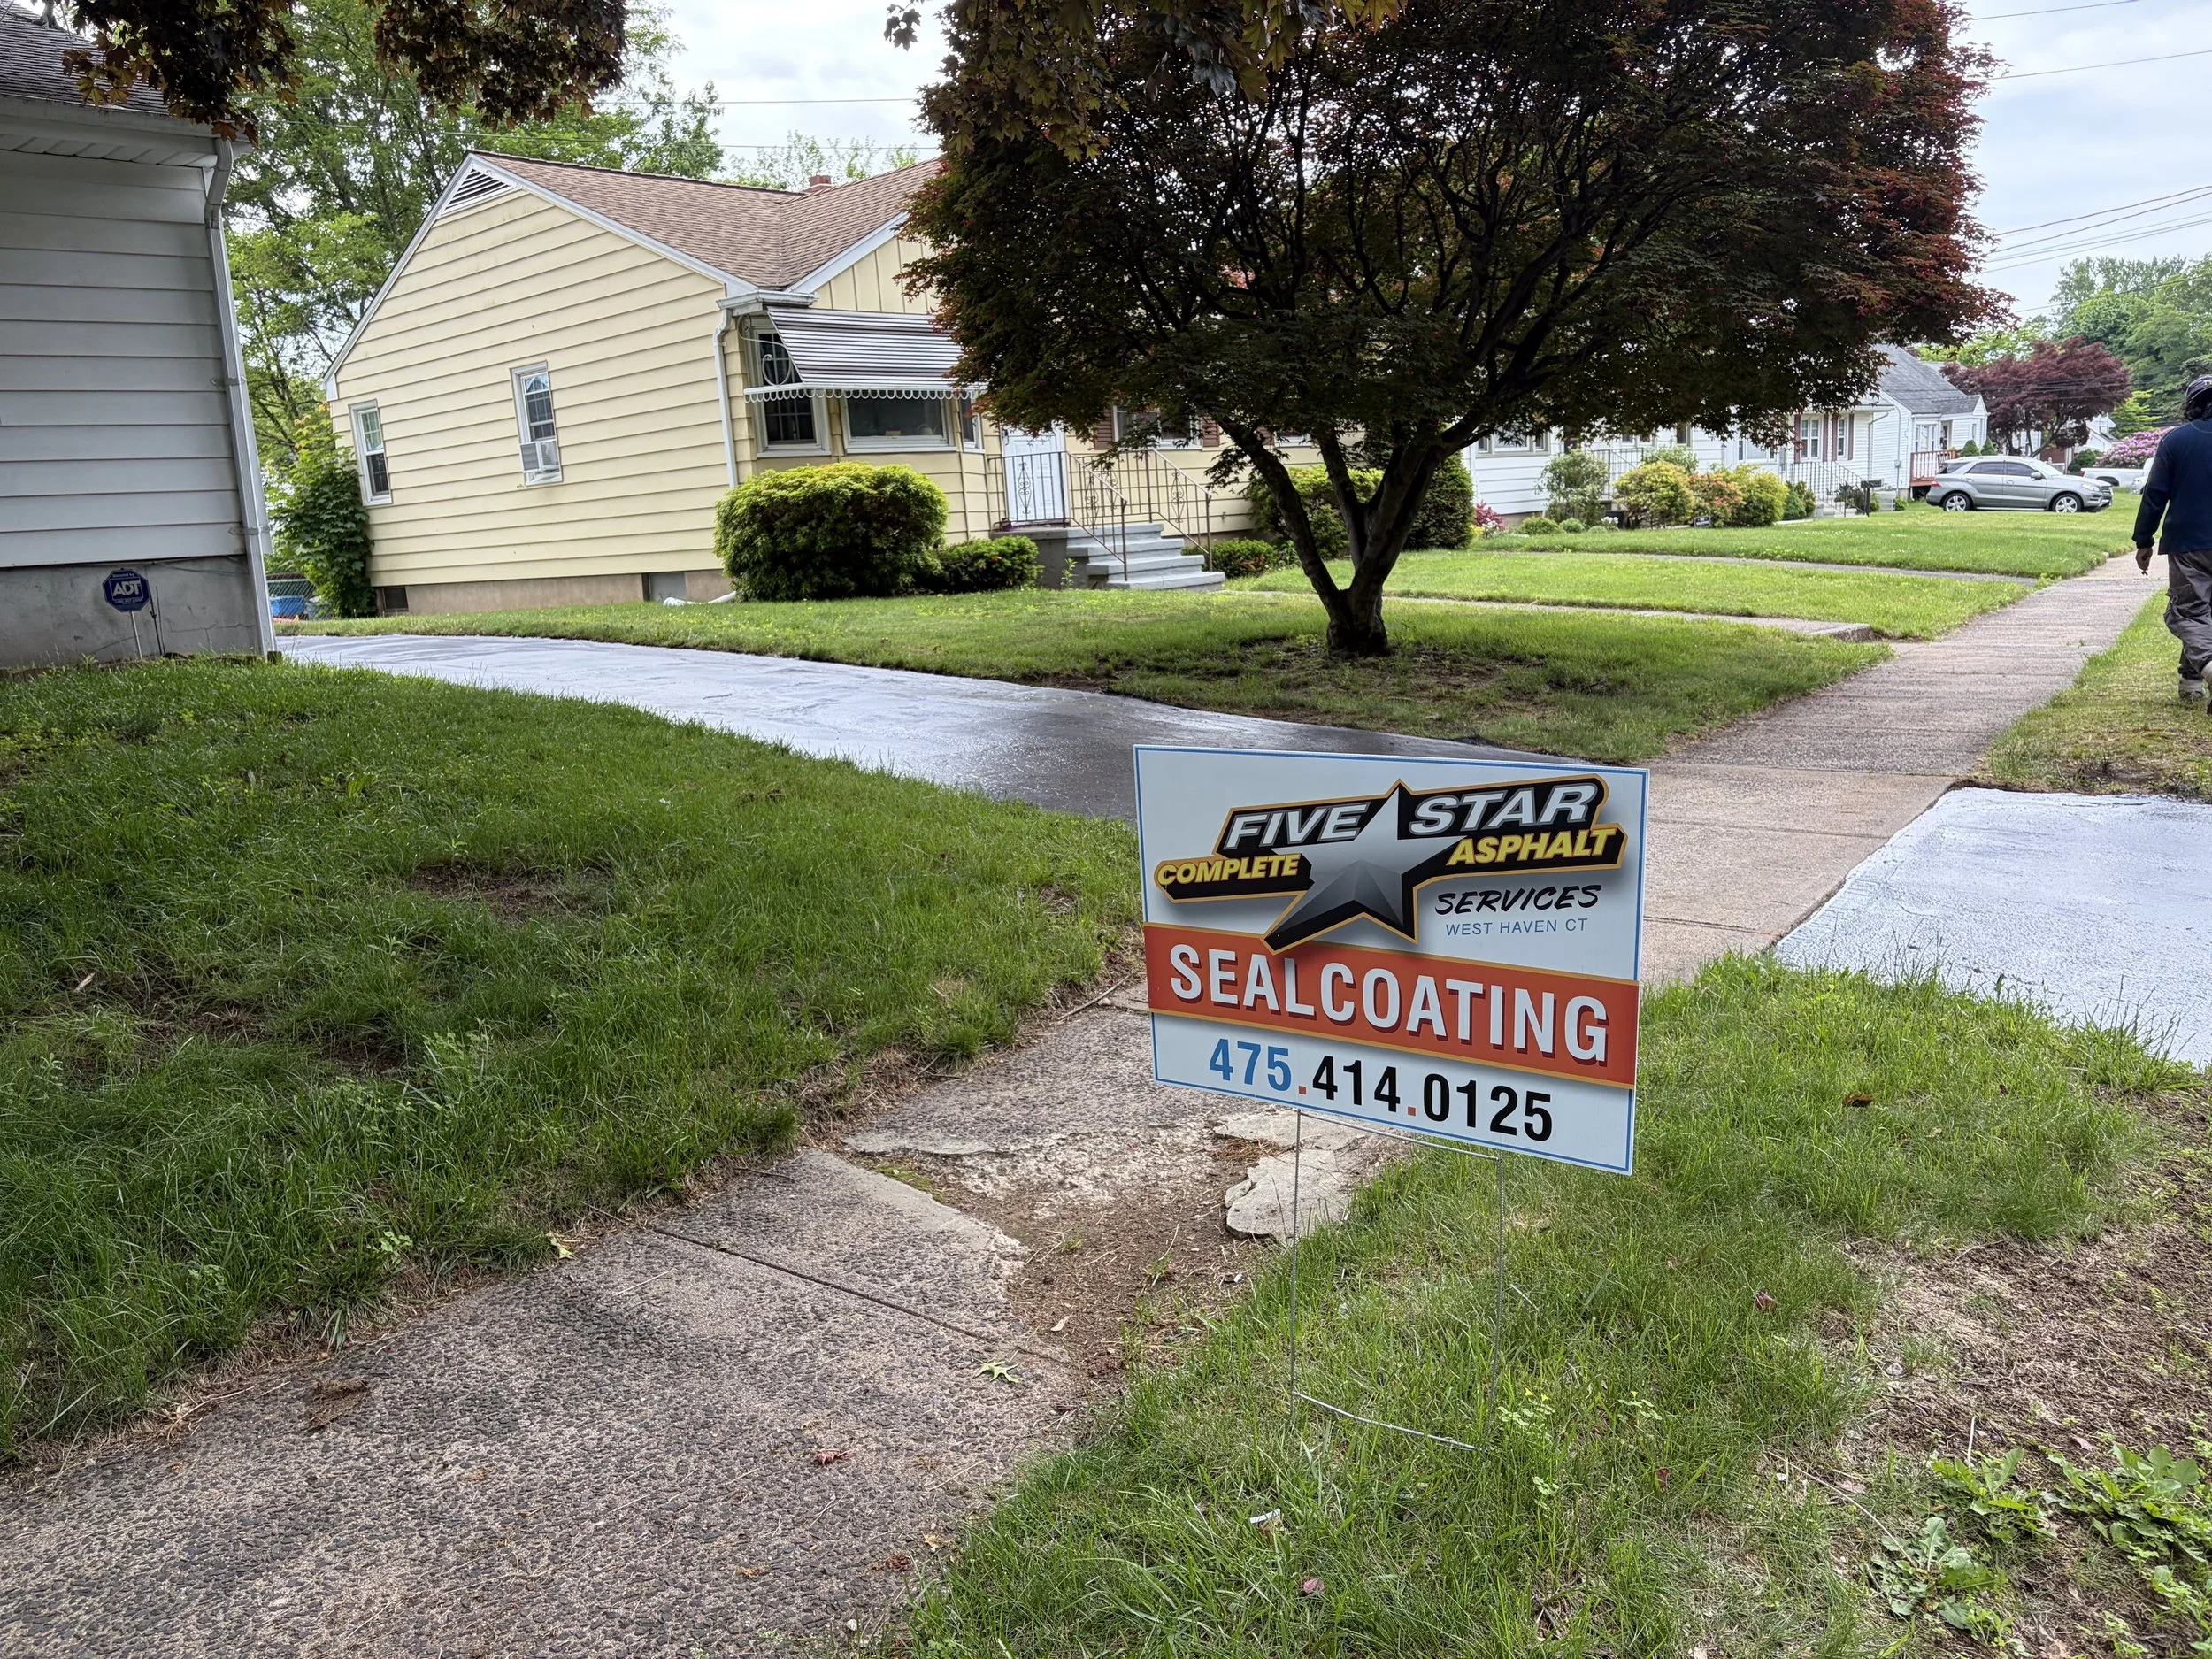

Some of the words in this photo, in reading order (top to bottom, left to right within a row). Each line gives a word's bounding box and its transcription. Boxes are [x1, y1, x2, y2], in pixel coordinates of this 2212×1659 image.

[113, 580, 142, 596] ADT
[1223, 802, 1371, 850] FIVE
[1409, 782, 1598, 835] STAR
[1156, 853, 1302, 886] COMPLETE
[1446, 828, 1617, 866] ASPHALT
[1434, 885, 1601, 916] SERVICES
[1445, 922, 1493, 936] WEST
[1500, 919, 1557, 934] HAVEN
[1565, 918, 1588, 932] CT
[1170, 943, 1607, 1064] SEALCOATING
[1209, 1038, 1553, 1141] 475.414.0125
